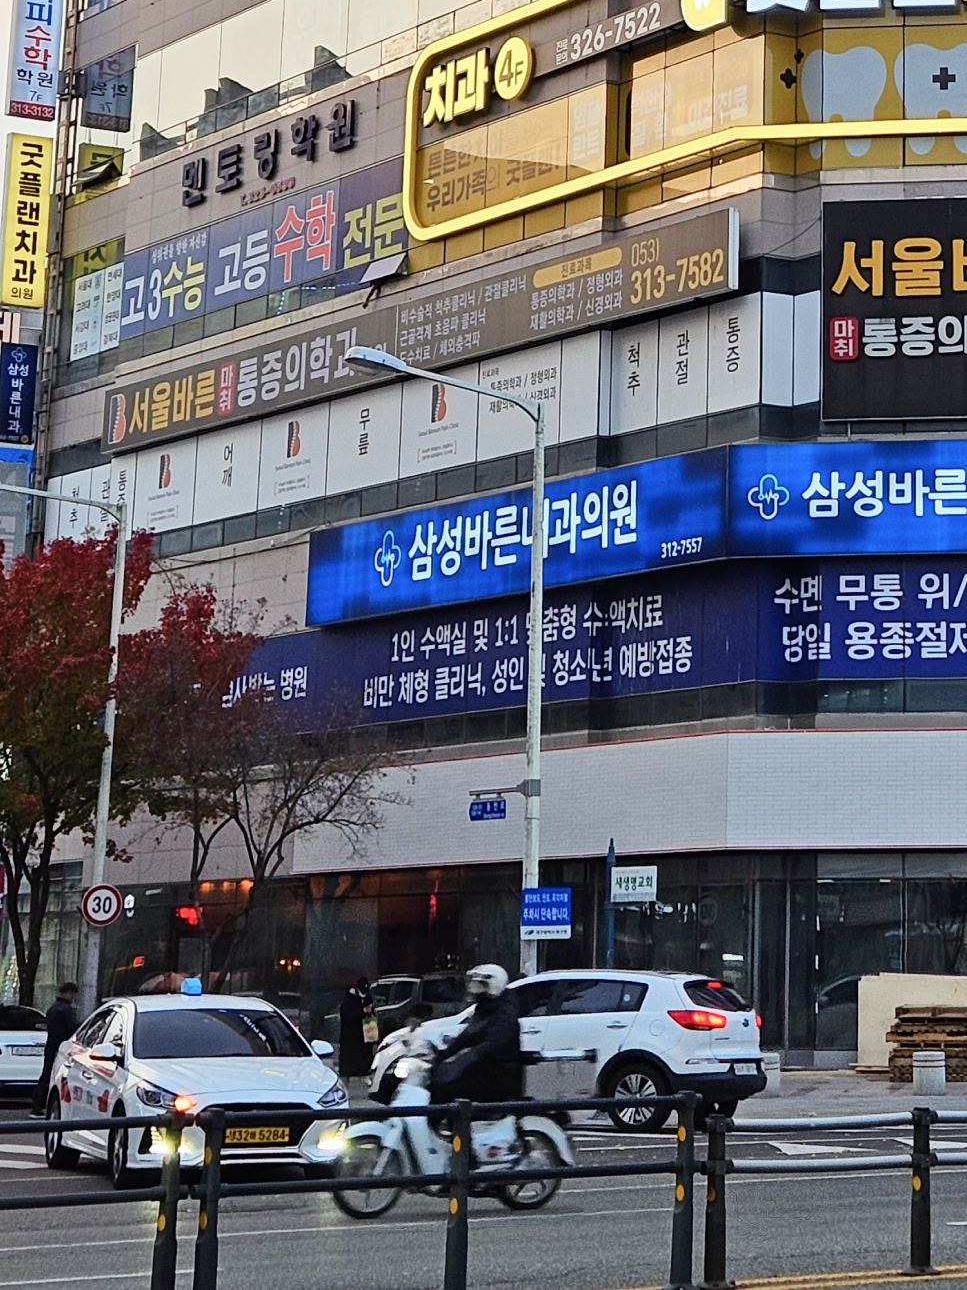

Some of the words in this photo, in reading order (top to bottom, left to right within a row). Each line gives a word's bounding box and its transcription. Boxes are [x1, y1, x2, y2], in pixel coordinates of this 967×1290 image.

[570, 2, 661, 61] 326-7522
[16, 68, 53, 89] 학원
[29, 90, 43, 103] 7F
[424, 47, 490, 127] 치과
[498, 49, 525, 92] 4F
[11, 102, 54, 119] 313-3132
[182, 99, 356, 208] 멘토링학원
[13, 142, 44, 285] 굿플랜치과
[560, 262, 592, 279] 진료과목
[631, 237, 660, 268] 053)
[10, 286, 34, 301] 의원
[630, 248, 725, 305] 313-7582
[400, 324, 431, 347] 근골격계
[434, 317, 459, 340] 초음파
[461, 308, 487, 330] 클리닉
[401, 302, 433, 324] 비수술적
[675, 329, 690, 387] 관절
[725, 316, 742, 374] 통증
[833, 319, 855, 358] 마취
[7, 364, 30, 377] 삼성
[129, 369, 215, 434] 서울바른
[218, 365, 234, 412] 마취
[237, 327, 358, 407] 통증의학과
[530, 367, 557, 386] 정형외과
[626, 342, 643, 397] 척추
[7, 378, 24, 433] 바른내과
[358, 408, 371, 456] 무릎
[221, 443, 234, 488] 어깨
[408, 479, 638, 583] 삼성바른내과의원
[660, 536, 703, 560] 312-7557
[836, 573, 903, 611] 무통
[391, 631, 416, 663] 1인
[420, 620, 468, 660] 수액실
[474, 618, 489, 652] 및
[494, 618, 519, 647] 1:1
[782, 622, 832, 663] 당일
[363, 675, 394, 709] 비만
[399, 668, 429, 705] 체형
[435, 664, 487, 700] 클리닉,
[491, 656, 524, 693] 성인
[620, 636, 693, 678] 예방접종
[615, 875, 653, 891] 새생명교회
[92, 896, 113, 915] 30
[259, 1129, 286, 1142] 5284
